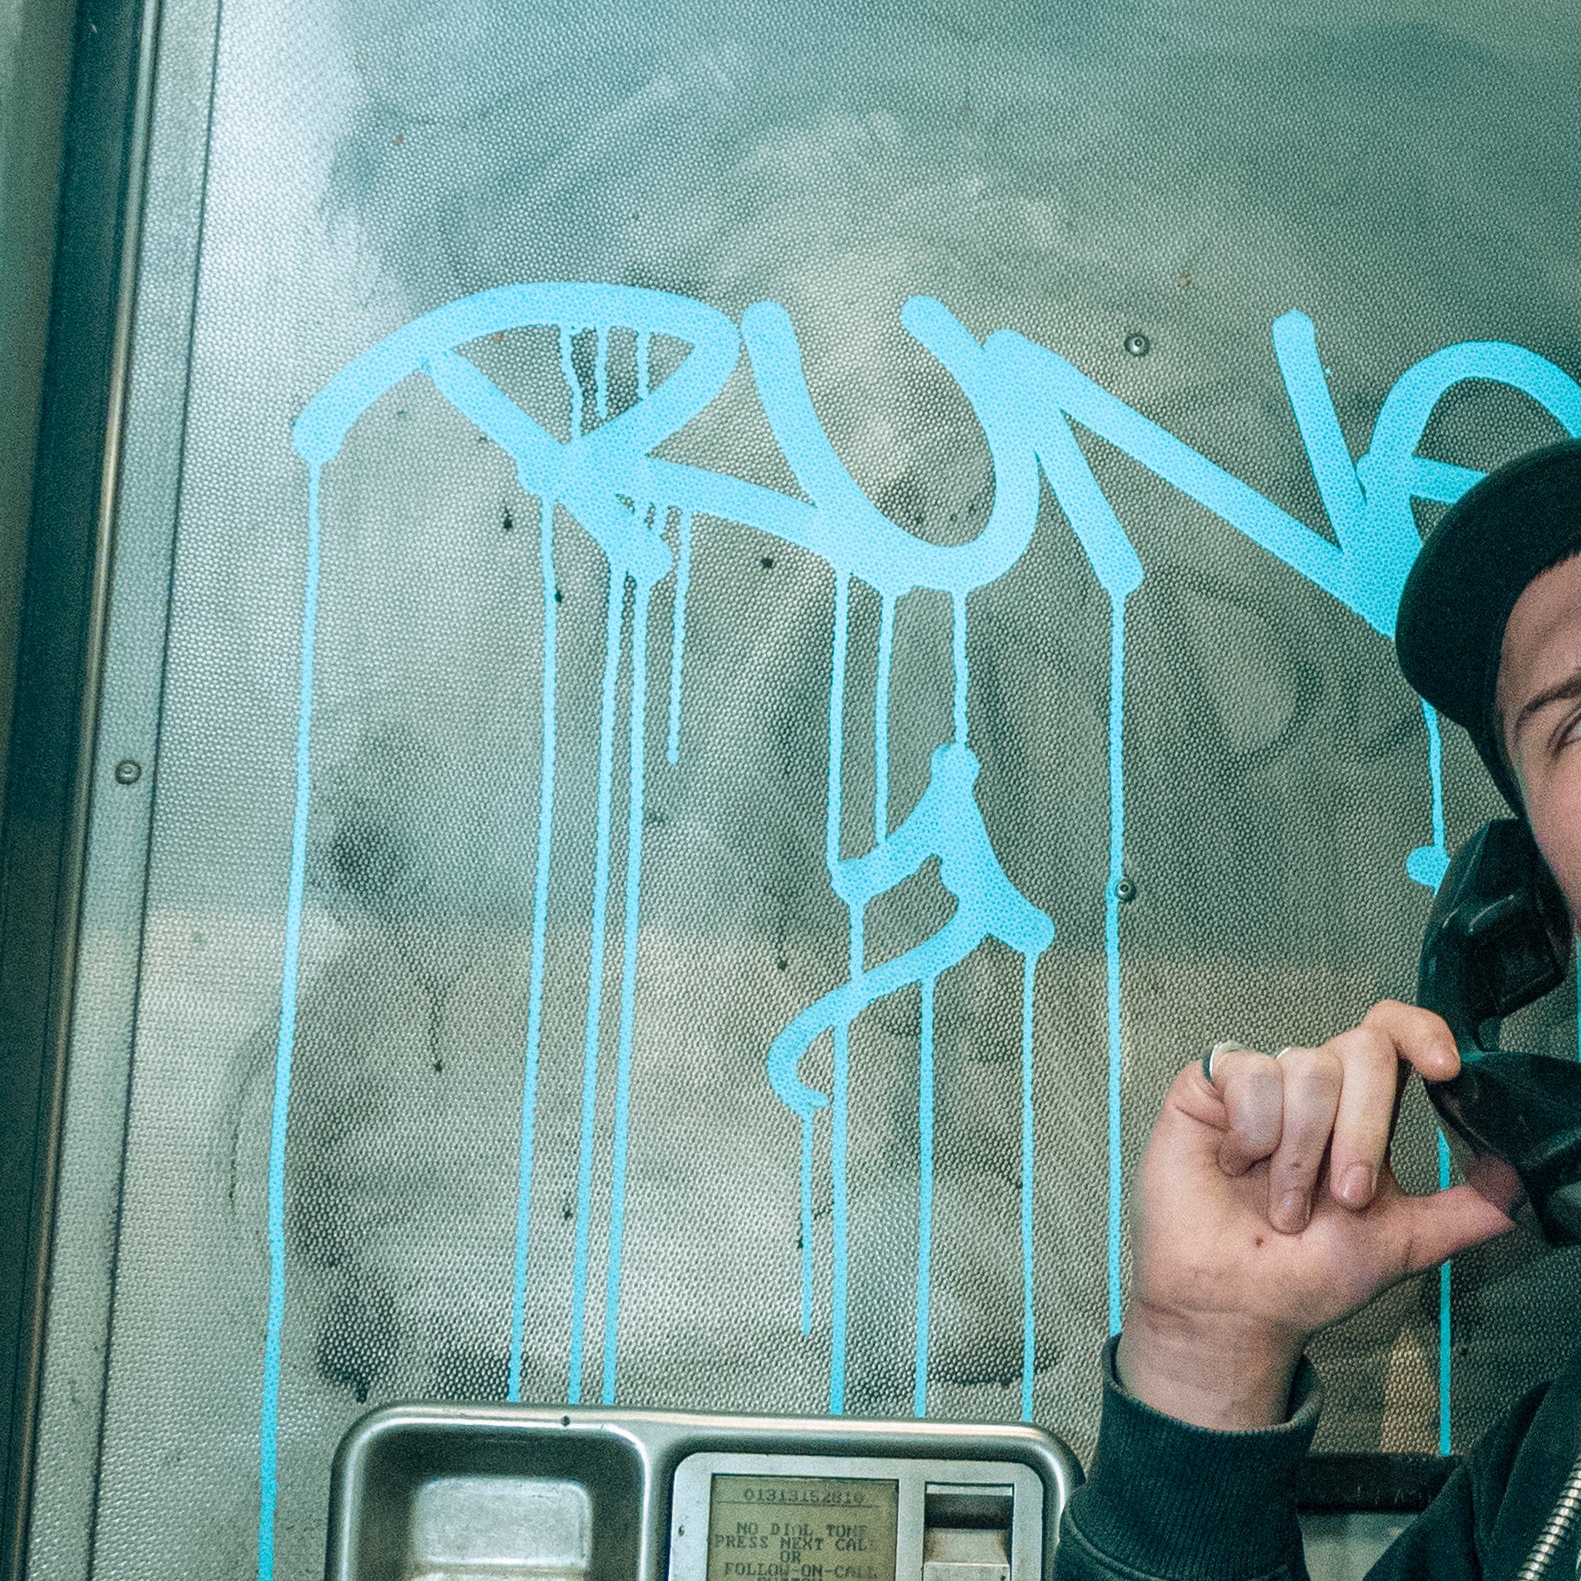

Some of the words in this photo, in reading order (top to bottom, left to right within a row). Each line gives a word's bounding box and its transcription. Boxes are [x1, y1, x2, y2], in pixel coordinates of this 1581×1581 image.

[736, 1522, 759, 1535] NO
[714, 1534, 768, 1548] PRESS
[780, 1537, 824, 1550] NEXT
[780, 1551, 801, 1563] OR
